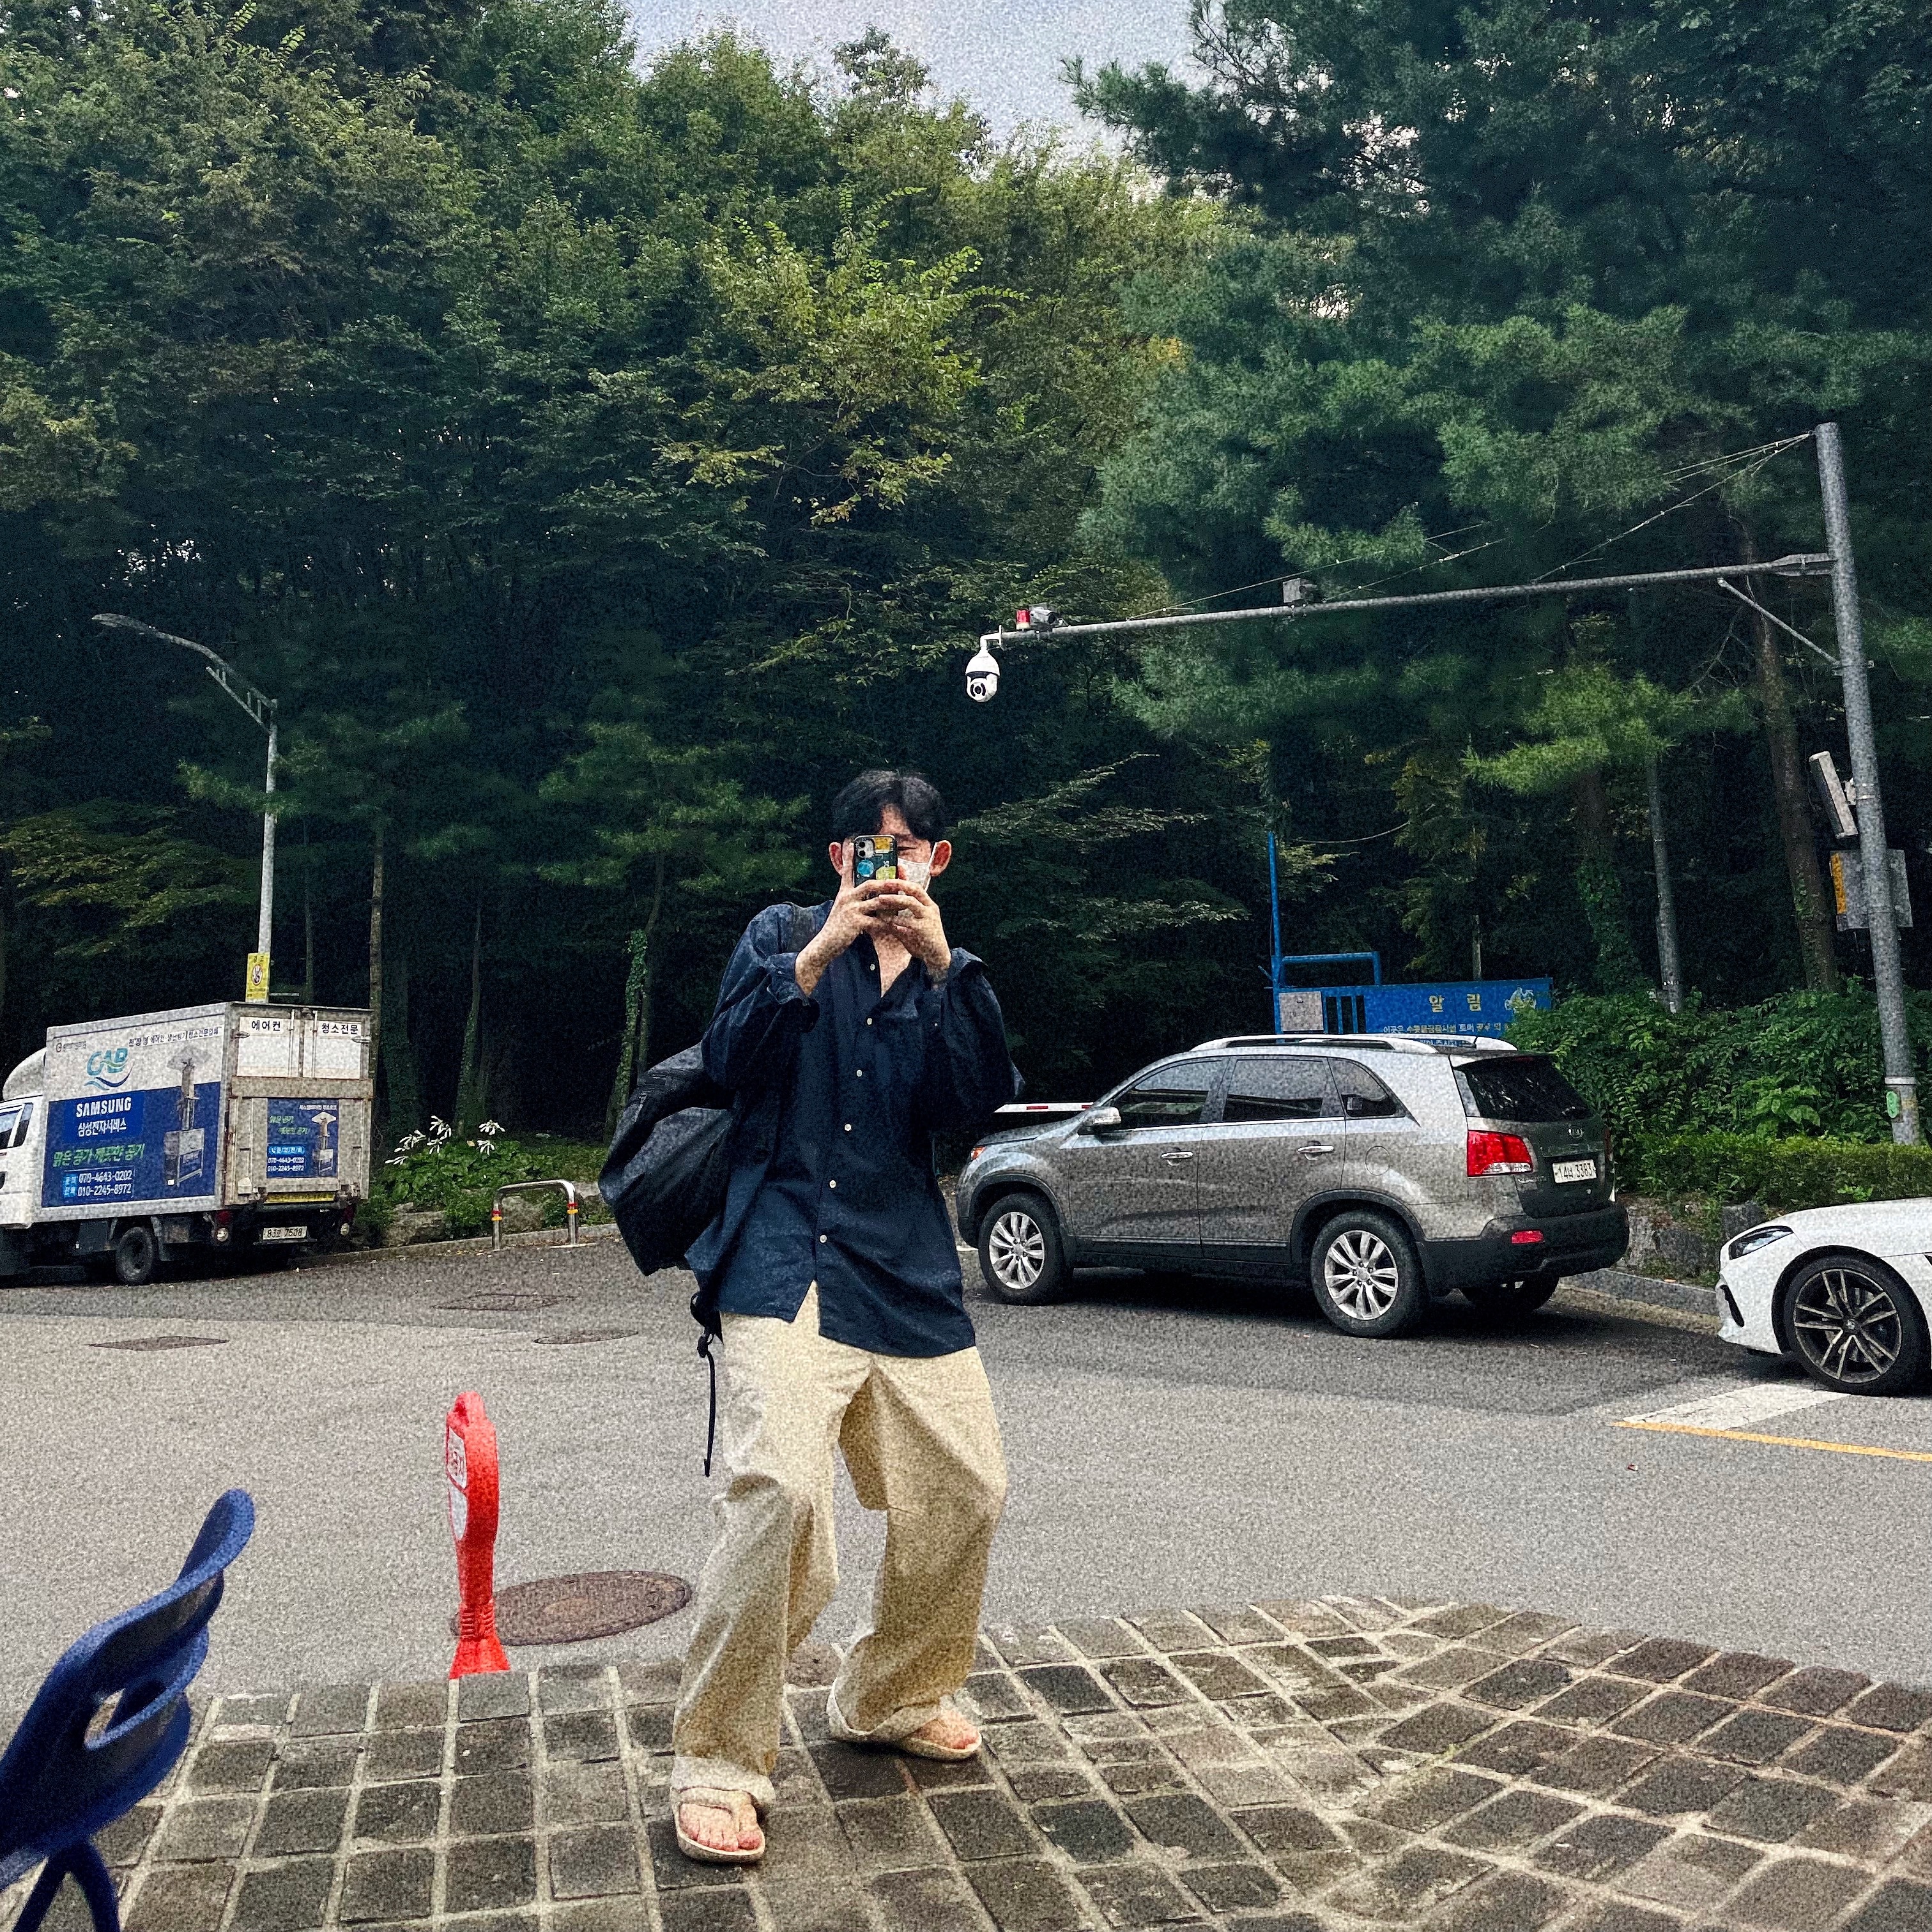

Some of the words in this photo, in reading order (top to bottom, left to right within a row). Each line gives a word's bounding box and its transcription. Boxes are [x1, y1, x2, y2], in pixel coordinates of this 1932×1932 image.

[1429, 993, 1482, 1013] 알림
[251, 1020, 280, 1032] 에어컨
[321, 1023, 358, 1035] 청소전문
[76, 1097, 132, 1117] SAMSUNG
[78, 1117, 127, 1137] 삼성전자서비스
[73, 1148, 93, 1166] 공기
[125, 1143, 145, 1161] 공기
[79, 1170, 132, 1183] 070-4643-0202
[77, 1183, 132, 1197] 010-2245-8972
